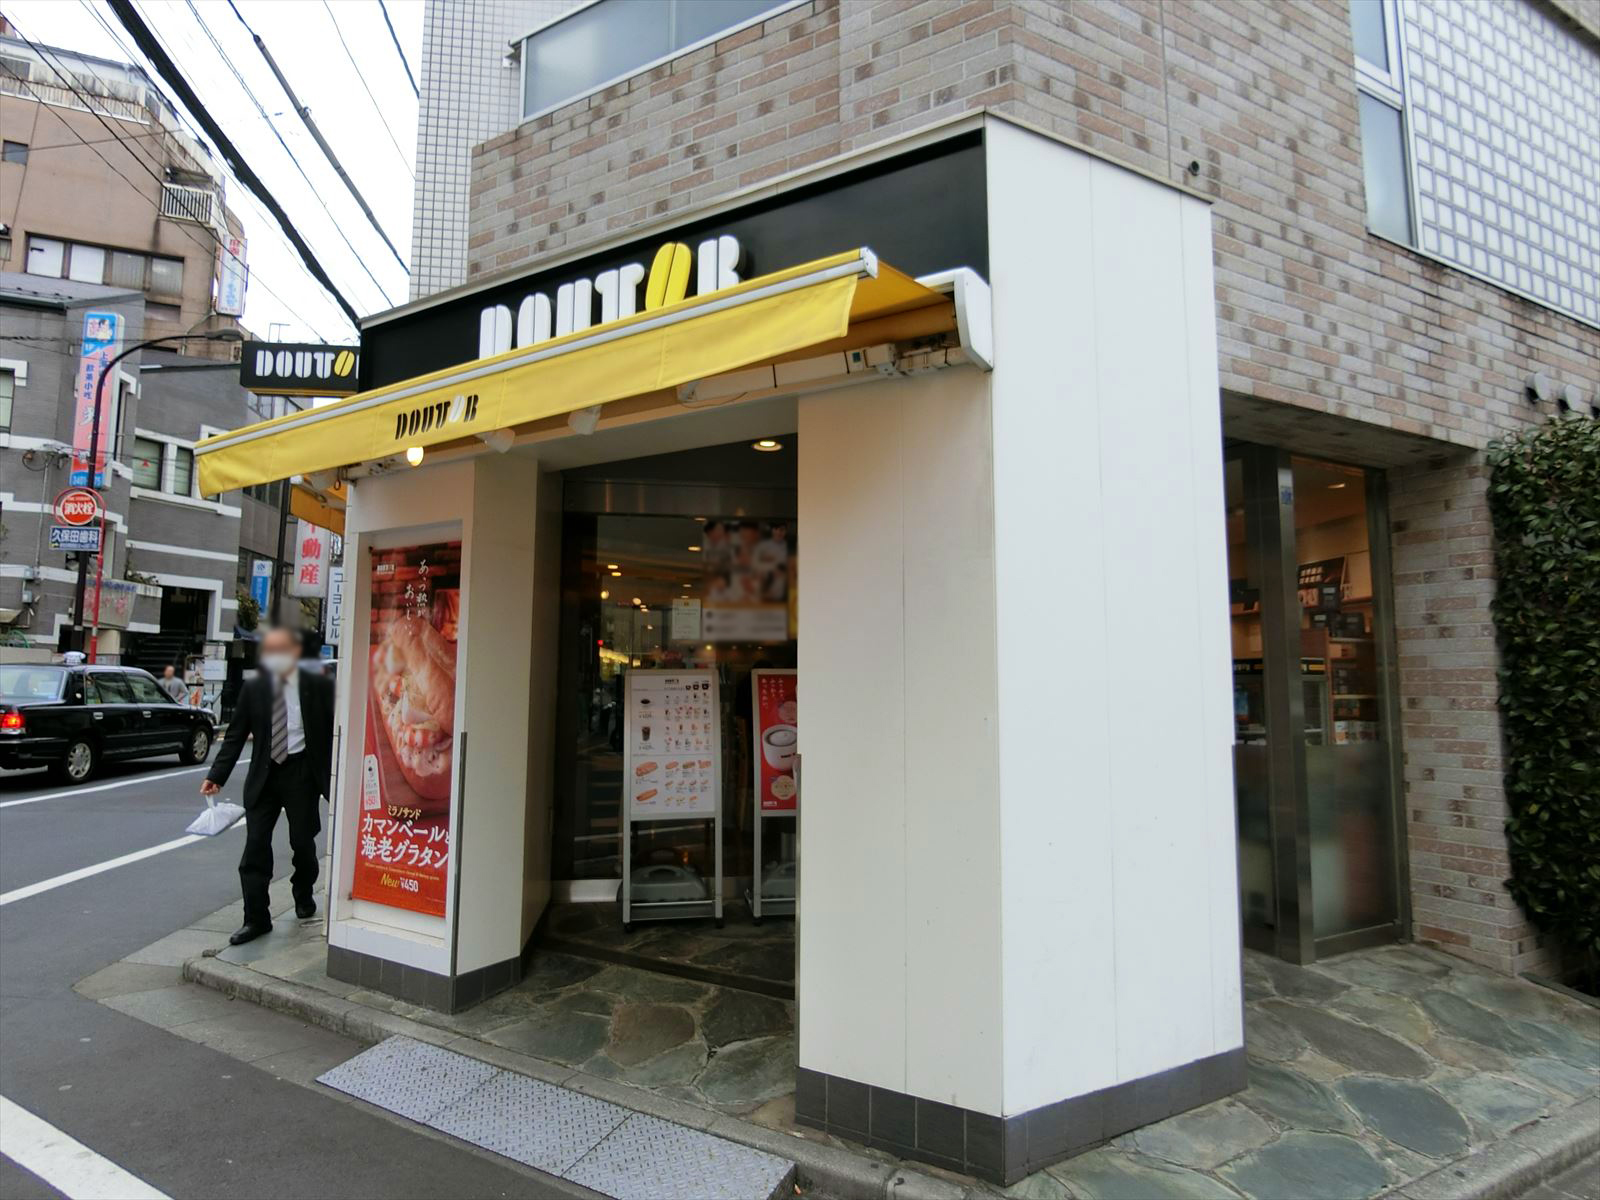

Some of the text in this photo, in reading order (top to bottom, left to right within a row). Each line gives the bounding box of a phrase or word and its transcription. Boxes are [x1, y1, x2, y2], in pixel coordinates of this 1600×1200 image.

[478, 235, 741, 361] DOUTOR
[255, 350, 359, 379] DOUTO
[395, 394, 479, 440] DOUTOR
[64, 502, 94, 515] 消火栓
[51, 529, 98, 543] 久保田歯科
[388, 805, 422, 820] ミラノサンド
[361, 832, 449, 868] 海老グラタン
[380, 872, 400, 888] New
